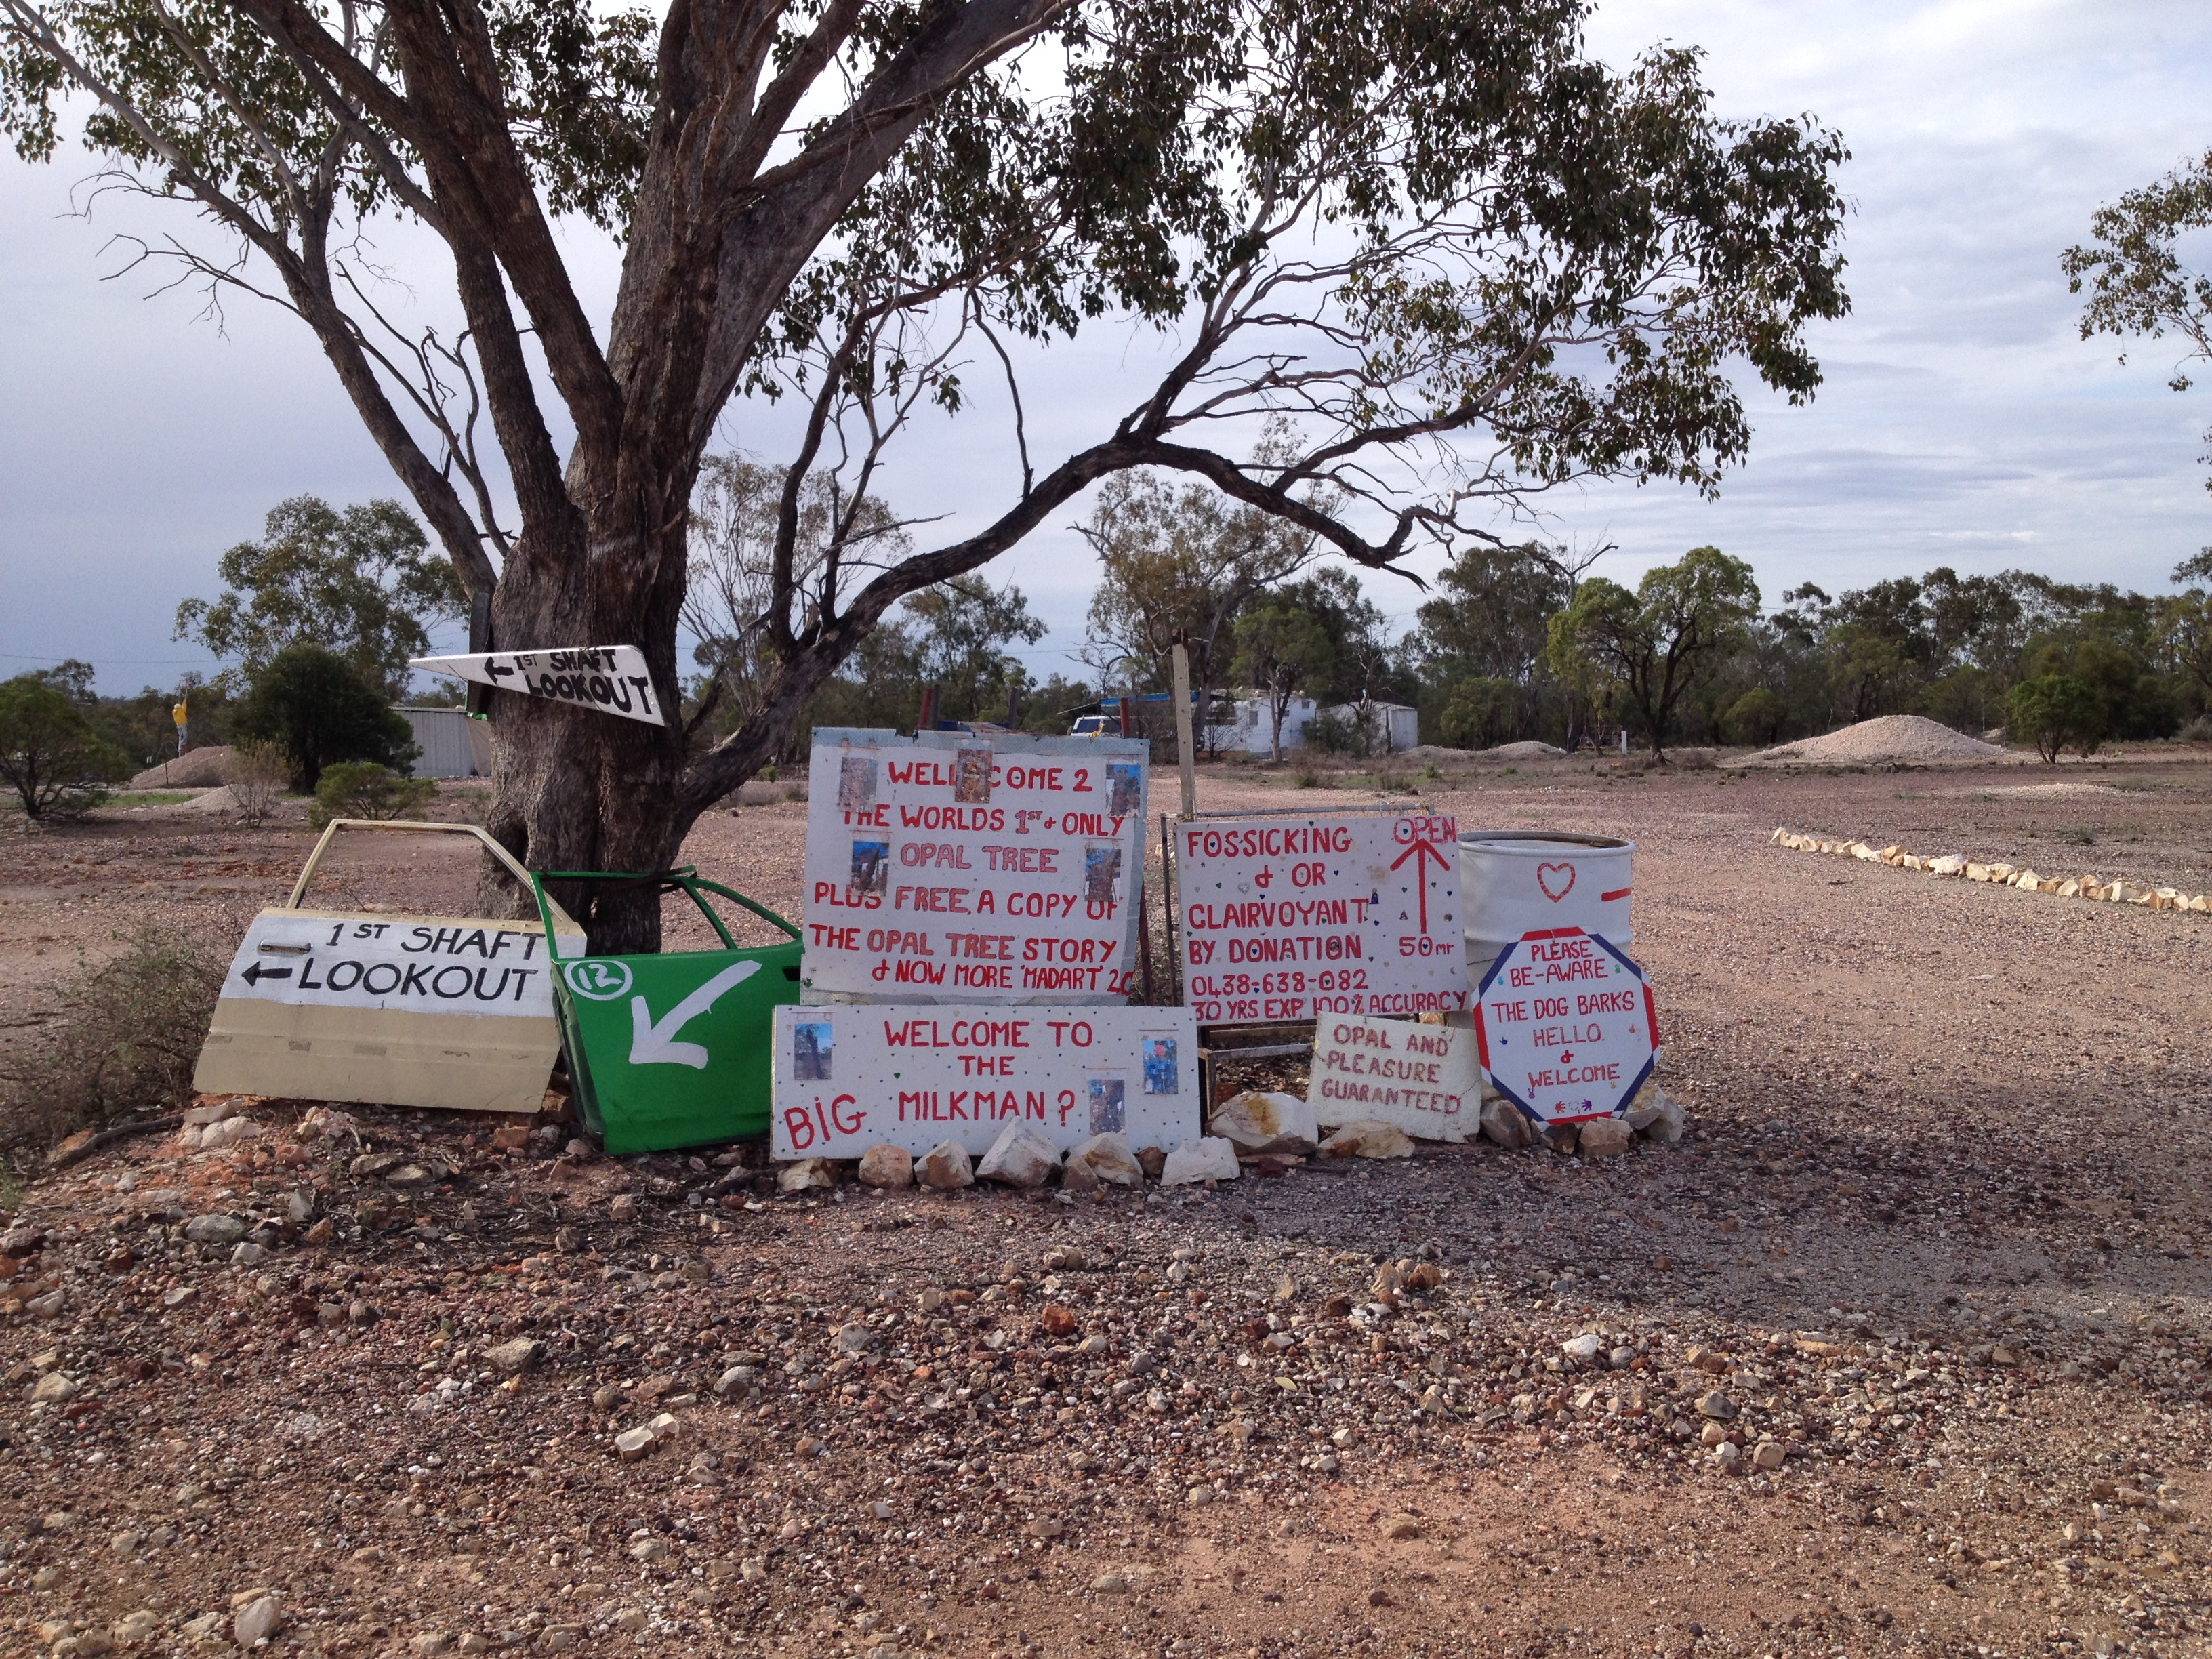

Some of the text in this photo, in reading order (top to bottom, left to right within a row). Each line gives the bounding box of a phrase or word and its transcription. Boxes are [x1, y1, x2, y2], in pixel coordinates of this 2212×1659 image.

[513, 649, 617, 674] 1ST SHAFT
[525, 672, 653, 715] LOOKOUT
[1073, 769, 1092, 792] 2
[900, 805, 1005, 832] WORLDS
[1015, 810, 1043, 834] 1ST
[1061, 812, 1125, 837] ONLY
[1393, 816, 1457, 845] OPEN
[900, 842, 1059, 873] OPAL TREE
[1187, 826, 1351, 858] FOSSICKING
[1291, 862, 1326, 888] OR
[815, 882, 882, 909] PLUS
[977, 890, 995, 915] A
[1006, 892, 1078, 918] COPY
[1086, 896, 1124, 920] OF
[1188, 898, 1370, 930] CLAIRVOYANT
[401, 926, 546, 960] SHAFT
[808, 924, 1118, 964] THE OPAL TREE STORY
[1189, 935, 1362, 965] BY DONATION
[1530, 940, 1593, 962] PLEASE
[298, 957, 539, 1002] LOOKOUT
[578, 963, 623, 989] 12
[894, 960, 946, 985] NOW
[954, 964, 1013, 989] MORE
[1191, 968, 1369, 999] 0438-638-082
[1509, 958, 1608, 987] BE-AWARE
[1191, 1000, 1221, 1022] 30
[1227, 998, 1259, 1020] YRS
[1369, 990, 1467, 1014] ACCURACY
[1491, 990, 1635, 1023] THE DOG BARKS
[884, 1020, 1094, 1048] WELCOME TO
[1333, 1023, 1449, 1057] OPAL AND
[1532, 1023, 1601, 1048] HELLO
[957, 1054, 1015, 1076] THE
[1326, 1050, 1441, 1084] PLEASURE
[1528, 1063, 1621, 1088] WELCOME
[1322, 1078, 1462, 1115] GUARANTEED
